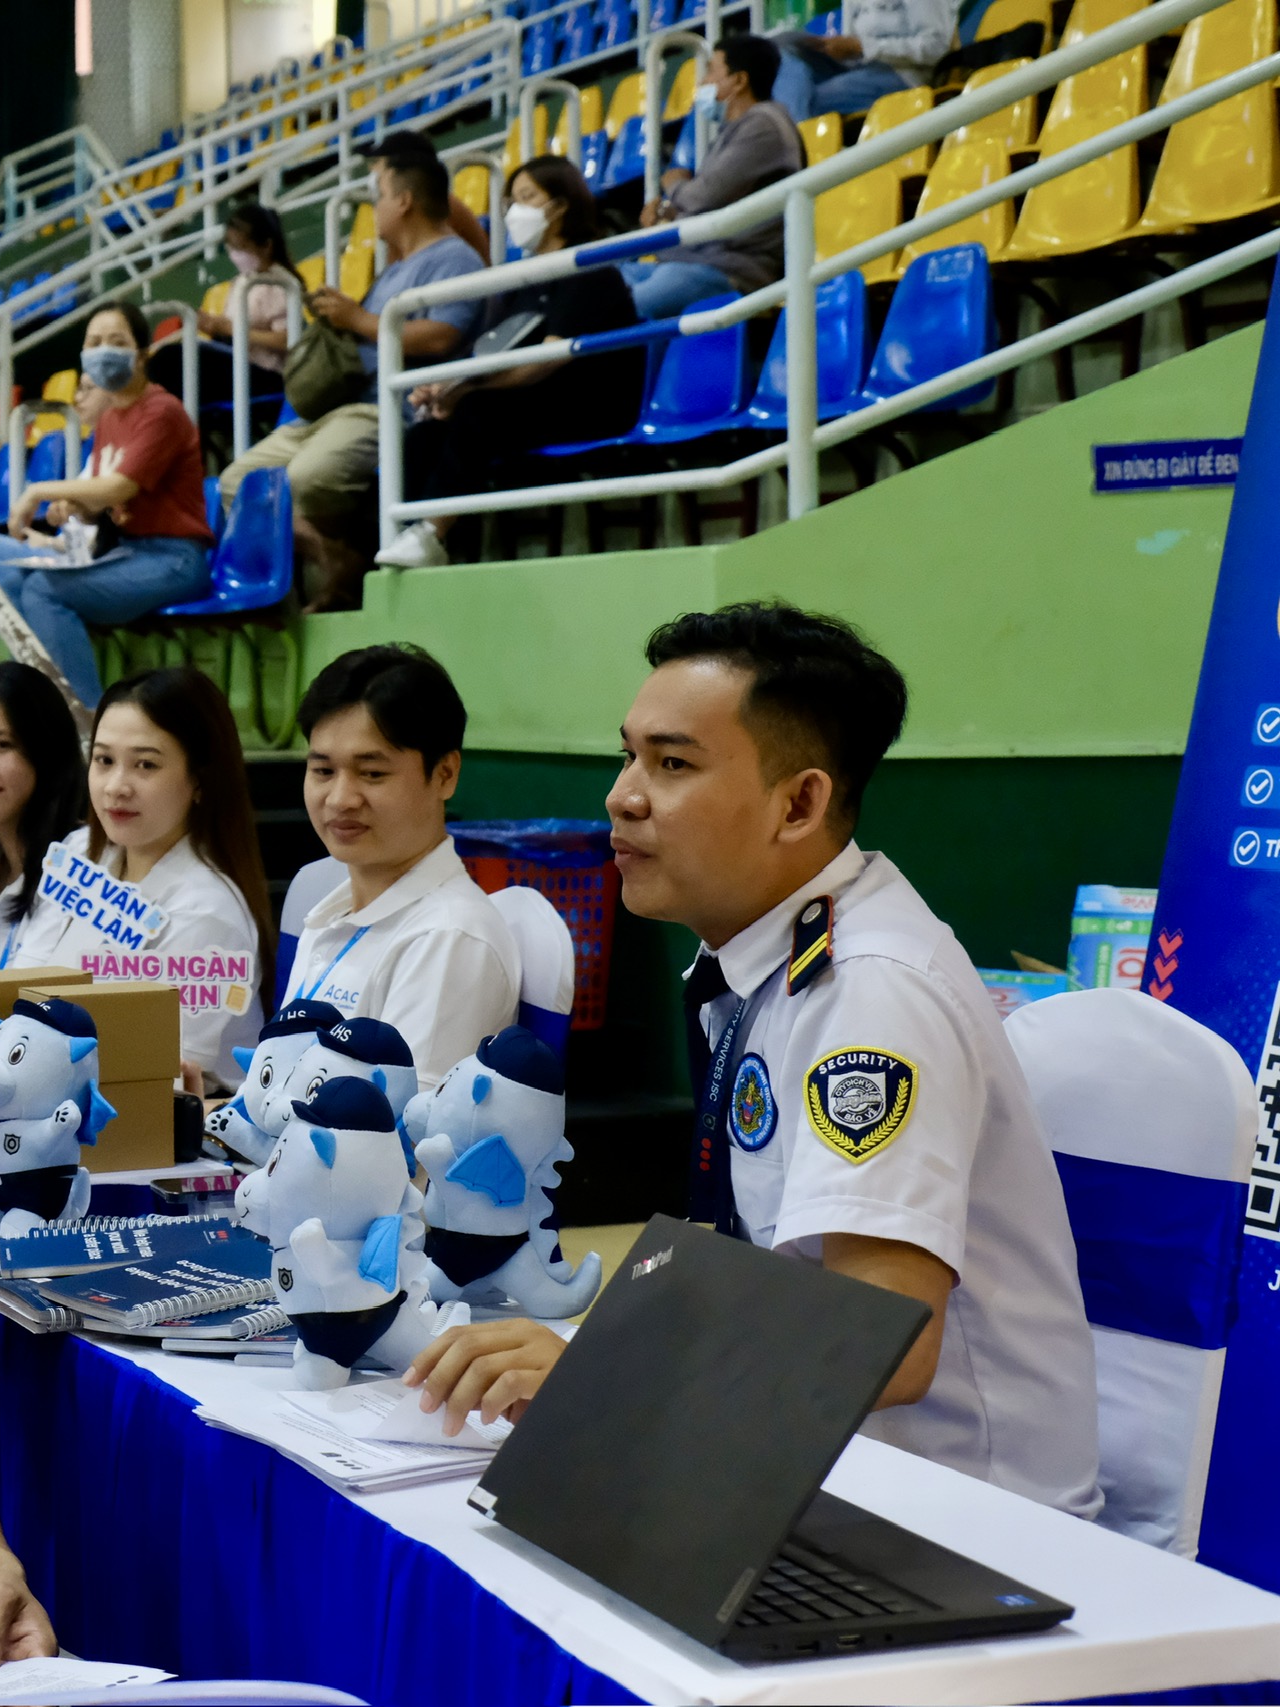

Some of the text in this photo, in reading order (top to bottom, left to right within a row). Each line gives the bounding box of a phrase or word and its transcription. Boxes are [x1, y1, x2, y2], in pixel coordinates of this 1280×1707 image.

[67, 856, 104, 888] TƯ
[42, 874, 144, 951] VIỆC LÀM
[81, 950, 246, 978] HÀNG NGÀN
[324, 984, 359, 1004] ACAC
[329, 1024, 352, 1042] LHS
[713, 1027, 734, 1080] SERVICES
[818, 1053, 898, 1075] SECURITY
[709, 1080, 720, 1102] JSC
